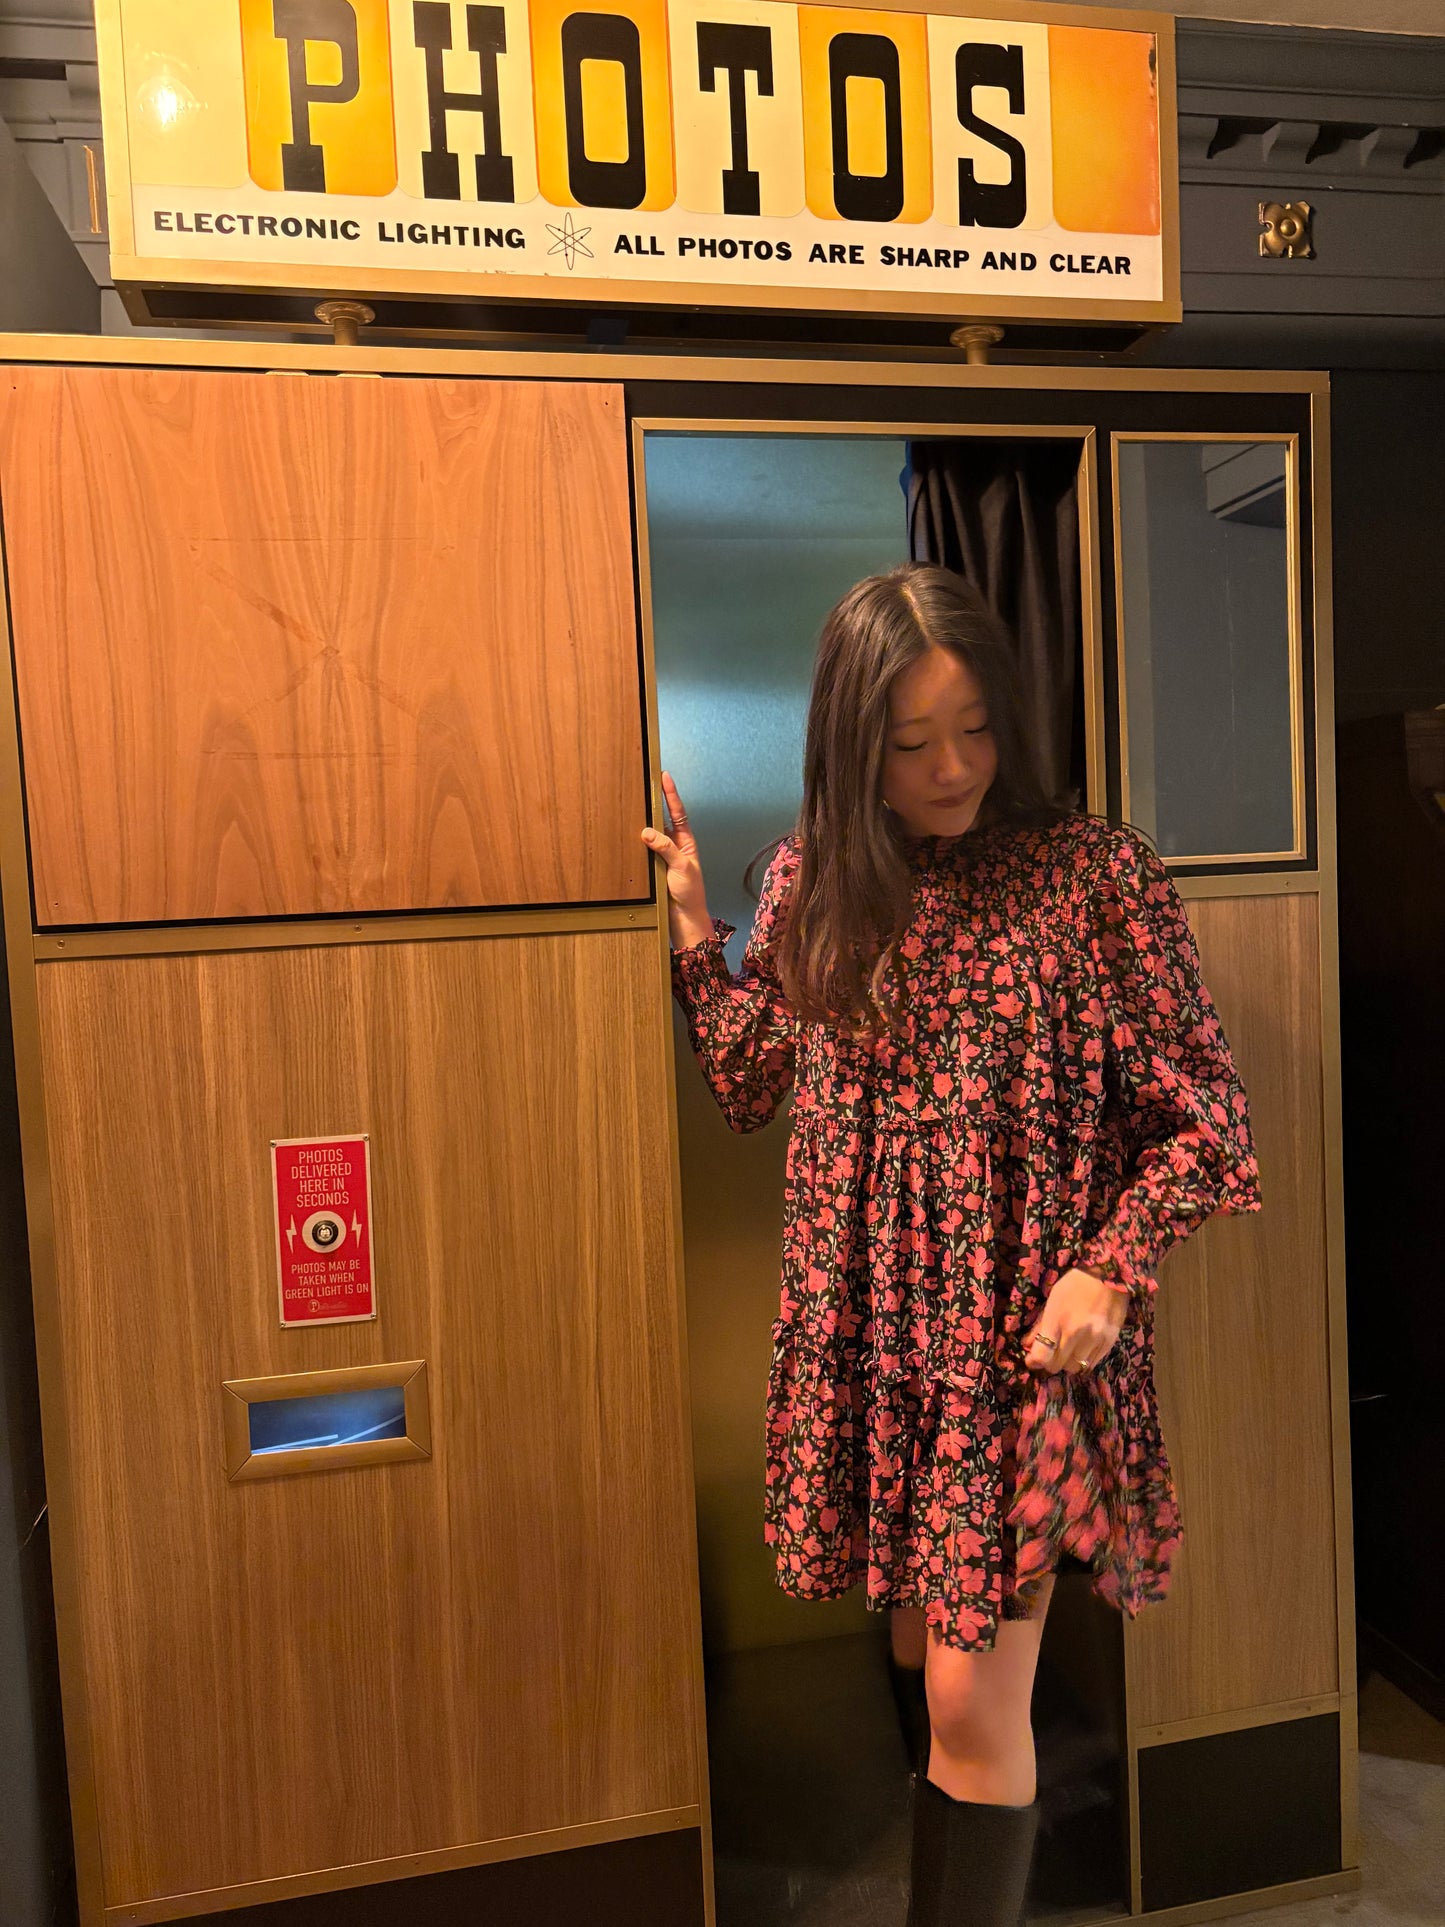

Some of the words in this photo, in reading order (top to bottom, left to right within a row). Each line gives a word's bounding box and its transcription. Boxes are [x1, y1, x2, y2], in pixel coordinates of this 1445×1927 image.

[273, 0, 1027, 229] PHOTOS
[154, 211, 361, 241] ELECTRONIC
[378, 222, 526, 249] LIGHTING
[614, 235, 665, 256] ALL
[678, 238, 792, 261] PHOTOS
[808, 243, 865, 265] ARE
[880, 246, 970, 269] SHARP
[981, 251, 1037, 271] AND
[1049, 254, 1131, 276] CLEAR
[298, 1149, 344, 1164] PHOTOS
[291, 1163, 352, 1179] DELIVERED
[300, 1179, 328, 1192] HERE
[333, 1177, 345, 1190] IN
[296, 1191, 349, 1207] SECONDS
[291, 1262, 326, 1274] PHOTOS
[328, 1260, 346, 1271] MAY
[349, 1258, 361, 1270] BE
[298, 1275, 327, 1286] TAKEN
[329, 1272, 355, 1283] WHEN
[285, 1287, 314, 1300] GREEN
[317, 1285, 341, 1297] LIGHT
[345, 1284, 353, 1295] IS
[356, 1283, 369, 1294] ON
